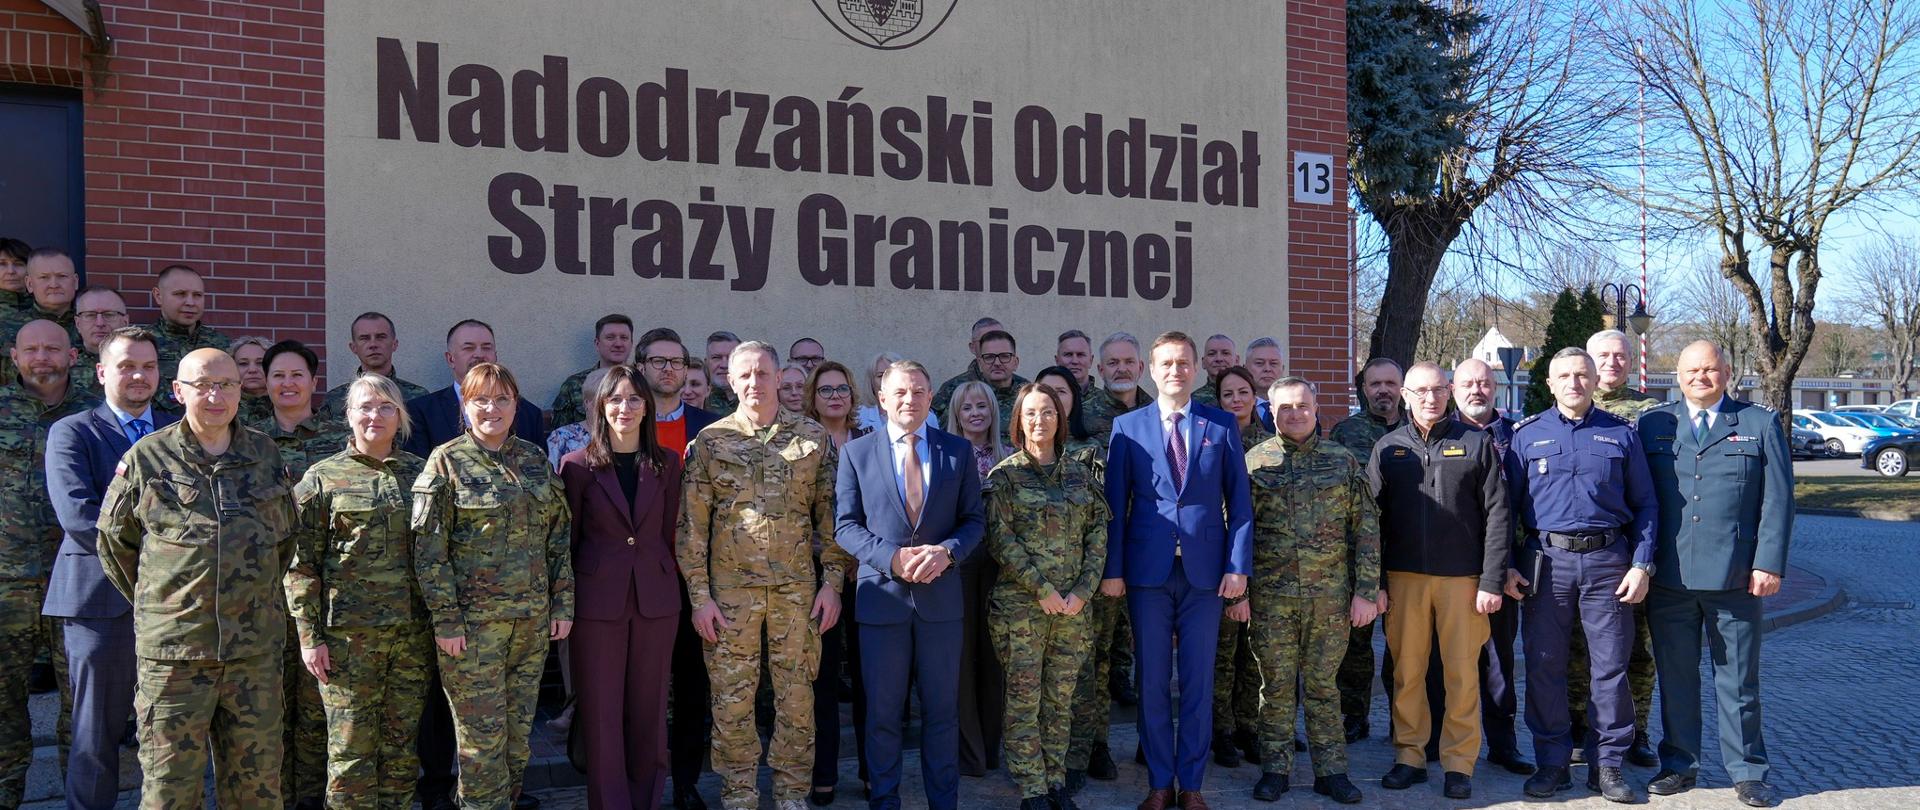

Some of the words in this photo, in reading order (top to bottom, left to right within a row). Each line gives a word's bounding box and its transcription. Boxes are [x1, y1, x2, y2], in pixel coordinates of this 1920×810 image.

[377, 37, 993, 187] Nadodrzański
[1014, 105, 1261, 208] Oddział
[1297, 161, 1330, 194] 13
[488, 172, 775, 291] Straży
[797, 193, 1192, 308] Granicznej
